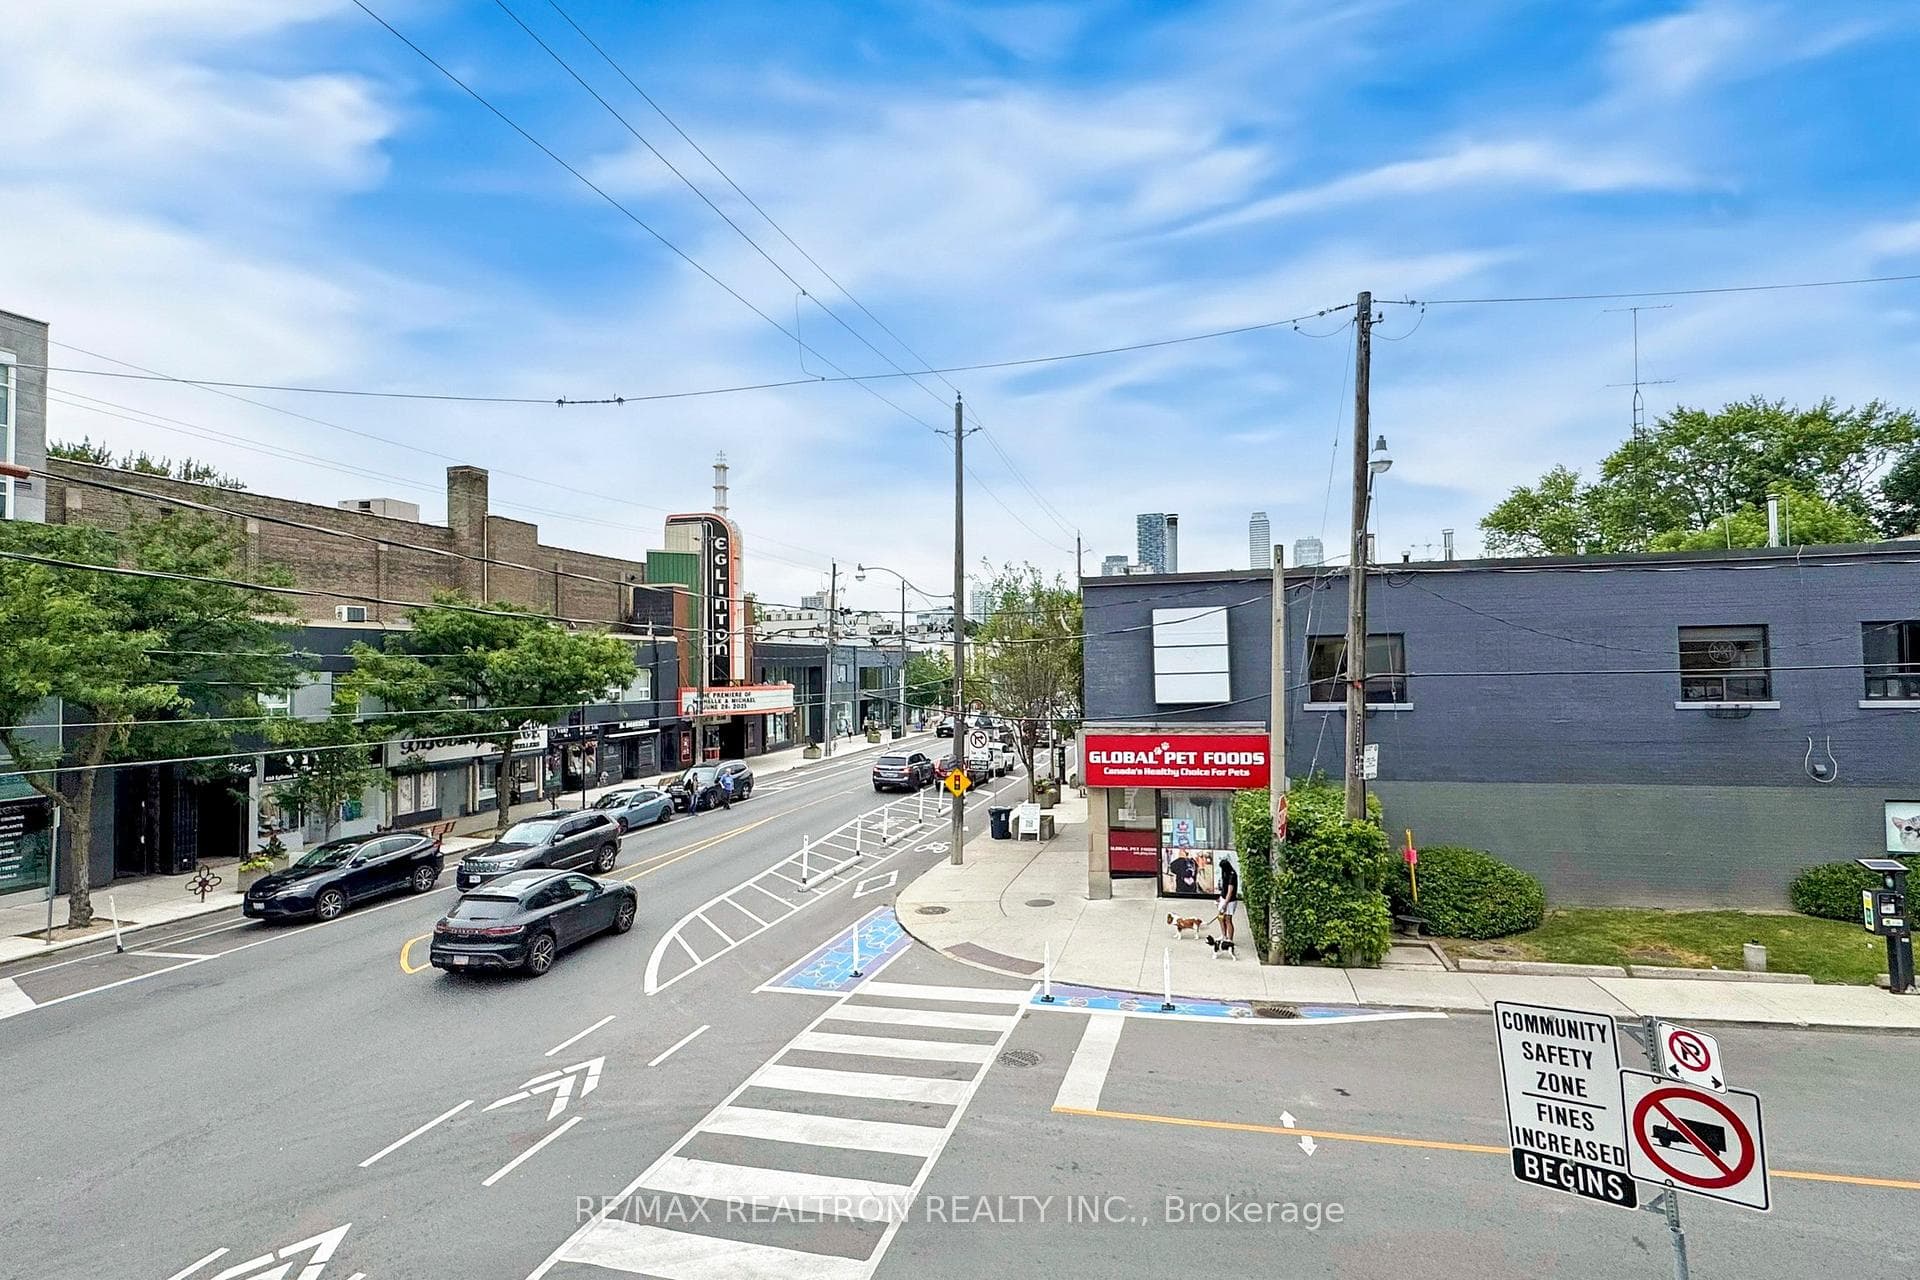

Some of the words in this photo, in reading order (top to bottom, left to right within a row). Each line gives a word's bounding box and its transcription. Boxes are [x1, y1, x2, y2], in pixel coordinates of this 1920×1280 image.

[714, 537, 728, 656] EGLINTON
[1089, 751, 1158, 765] GLOBAL
[1164, 751, 1198, 765] PET
[1203, 751, 1265, 766] FOODS
[1103, 767, 1143, 775] Canada's
[1144, 767, 1179, 778] Healthy
[1180, 768, 1210, 776] Choice
[1211, 768, 1227, 776] For
[1228, 768, 1251, 777] Pets
[1502, 1011, 1607, 1044] COMMUNITY
[1522, 1041, 1593, 1070] SAFETY
[1536, 1071, 1588, 1098] ZONE
[1536, 1103, 1595, 1132] FINES
[1515, 1126, 1625, 1167] INCREASED
[1523, 1152, 1624, 1202] BEGINS
